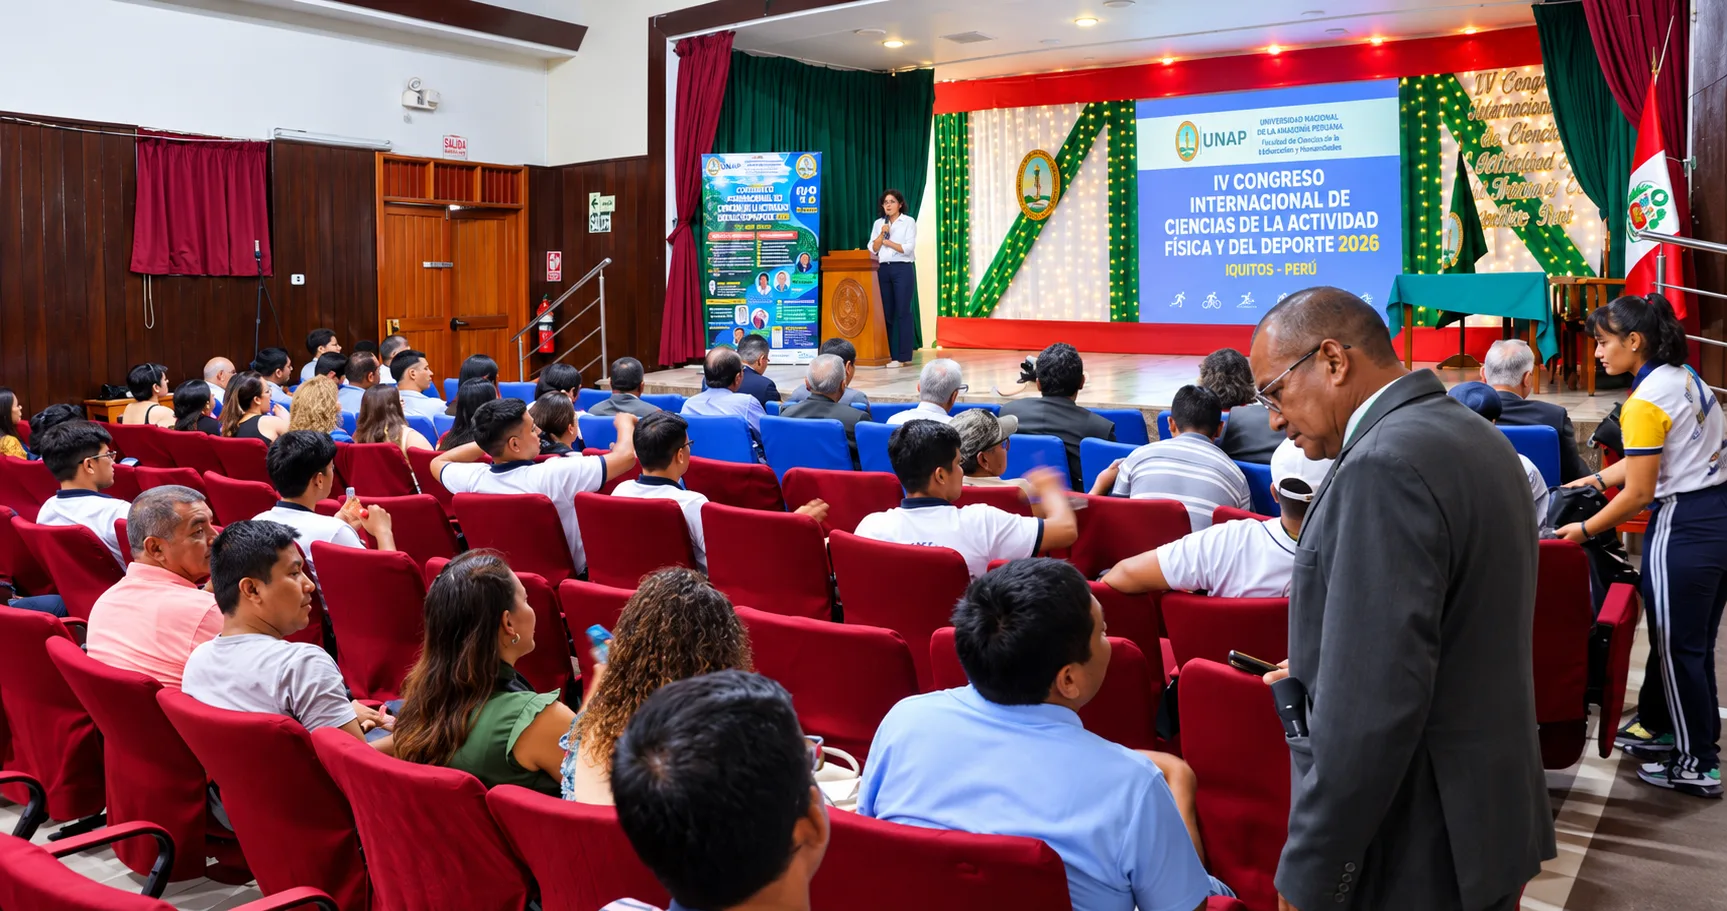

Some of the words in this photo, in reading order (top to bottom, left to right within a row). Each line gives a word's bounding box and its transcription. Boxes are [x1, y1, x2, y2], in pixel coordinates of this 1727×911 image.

[444, 138, 466, 150] SALIDA
[1203, 130, 1247, 148] UNAP
[1214, 174, 1230, 191] IV
[1233, 168, 1325, 190] CONGRESO
[1190, 191, 1323, 213] INTERNACIONAL
[1328, 190, 1350, 208] DE
[1164, 216, 1236, 236] CIENCIAS
[1239, 216, 1260, 233] DE
[1264, 215, 1284, 232] LA
[1287, 211, 1378, 231] ACTIVIDAD
[1164, 236, 1212, 256] FÍSICA
[1214, 239, 1225, 256] Y
[1228, 238, 1258, 255] DEL
[1261, 235, 1334, 254] DEPORTE
[1338, 234, 1380, 252] 2026
[1225, 263, 1274, 278] IQUITOS
[1284, 258, 1316, 276] PERÚ
